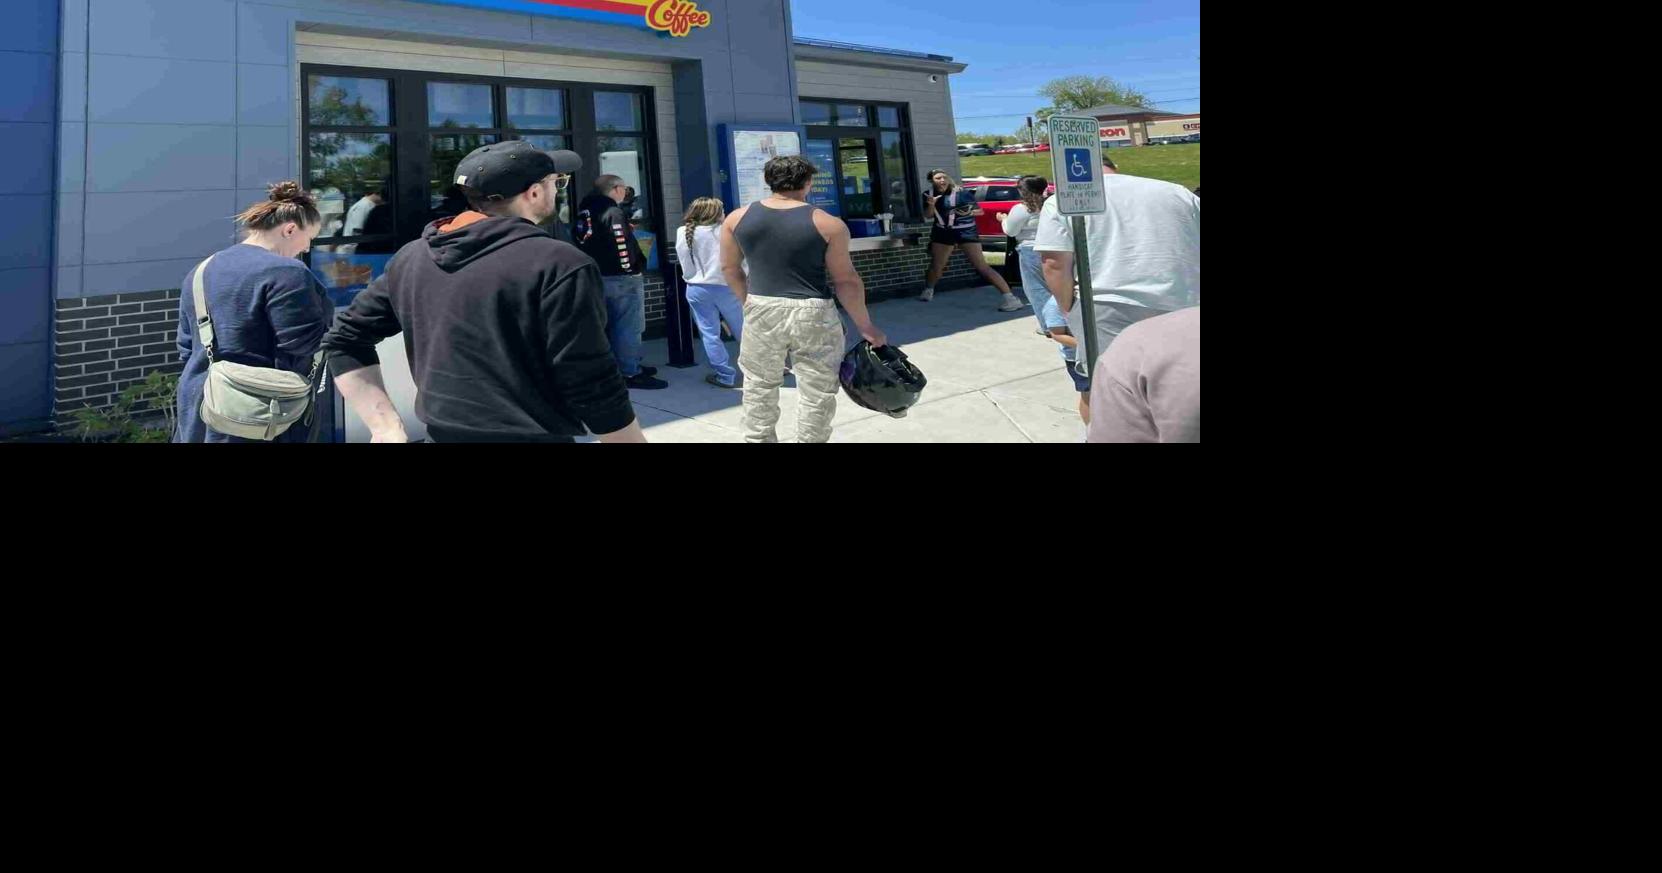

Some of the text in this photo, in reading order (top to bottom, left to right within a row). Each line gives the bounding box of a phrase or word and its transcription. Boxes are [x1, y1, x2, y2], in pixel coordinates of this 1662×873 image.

[648, 0, 708, 34] Coffee
[1053, 120, 1096, 133] RESERVED
[1057, 134, 1094, 147] PARKING
